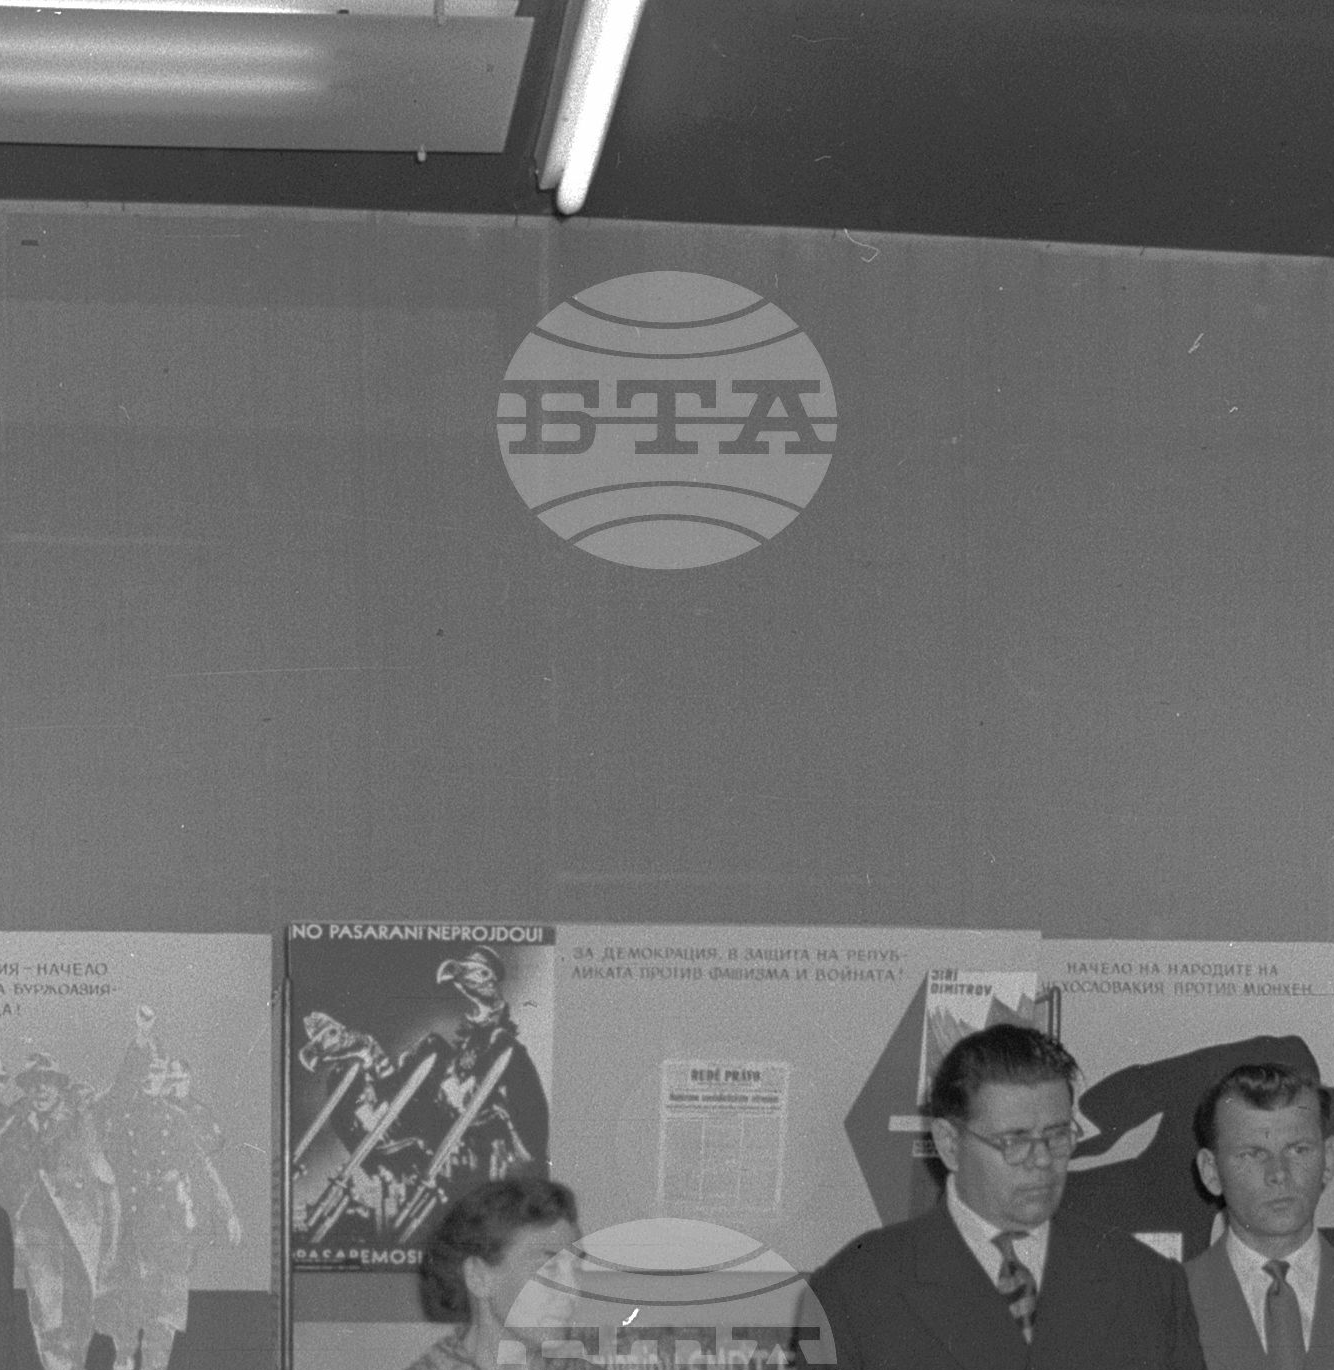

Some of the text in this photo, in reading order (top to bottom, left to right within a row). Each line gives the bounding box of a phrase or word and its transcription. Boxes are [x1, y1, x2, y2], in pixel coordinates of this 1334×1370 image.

[292, 924, 322, 939] NO
[572, 947, 594, 960] ЗА
[727, 948, 738, 960] В
[744, 948, 810, 962] ЗАЩИТА
[817, 949, 839, 961] НА
[36, 962, 108, 977] НАЧЕЛО
[571, 965, 634, 979] ЛИКАТА
[640, 966, 703, 980] ПРОТИВ
[708, 966, 789, 982] ФАШИЗМА
[795, 967, 808, 980] И
[1066, 962, 1279, 978] НАЧЕЛО НА НАРОДИТЕ НА
[929, 982, 994, 997] DIMITROV
[1173, 981, 1237, 995] ПРОТИВ
